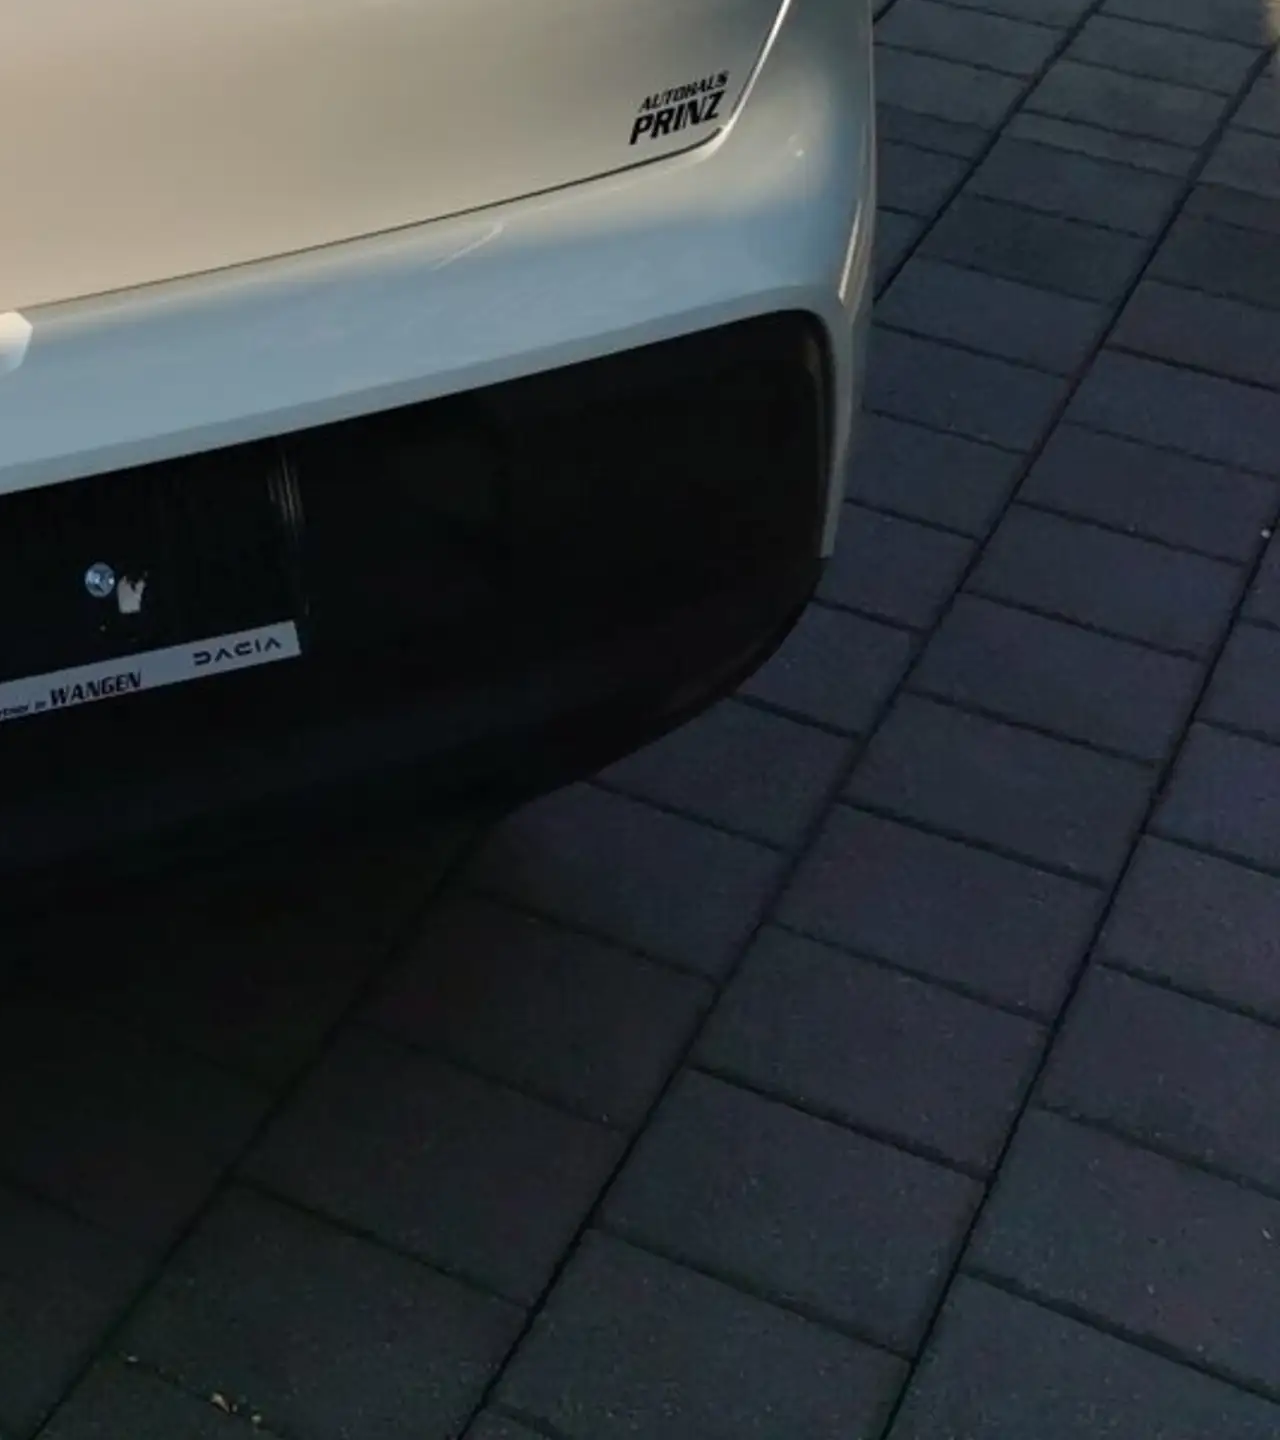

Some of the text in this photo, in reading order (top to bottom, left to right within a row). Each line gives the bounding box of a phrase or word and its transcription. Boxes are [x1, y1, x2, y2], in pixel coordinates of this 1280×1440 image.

[628, 88, 727, 145] PRINZ
[639, 69, 730, 111] AUTOHAUS
[49, 668, 142, 707] WANGEN
[192, 637, 282, 666] DACIA
